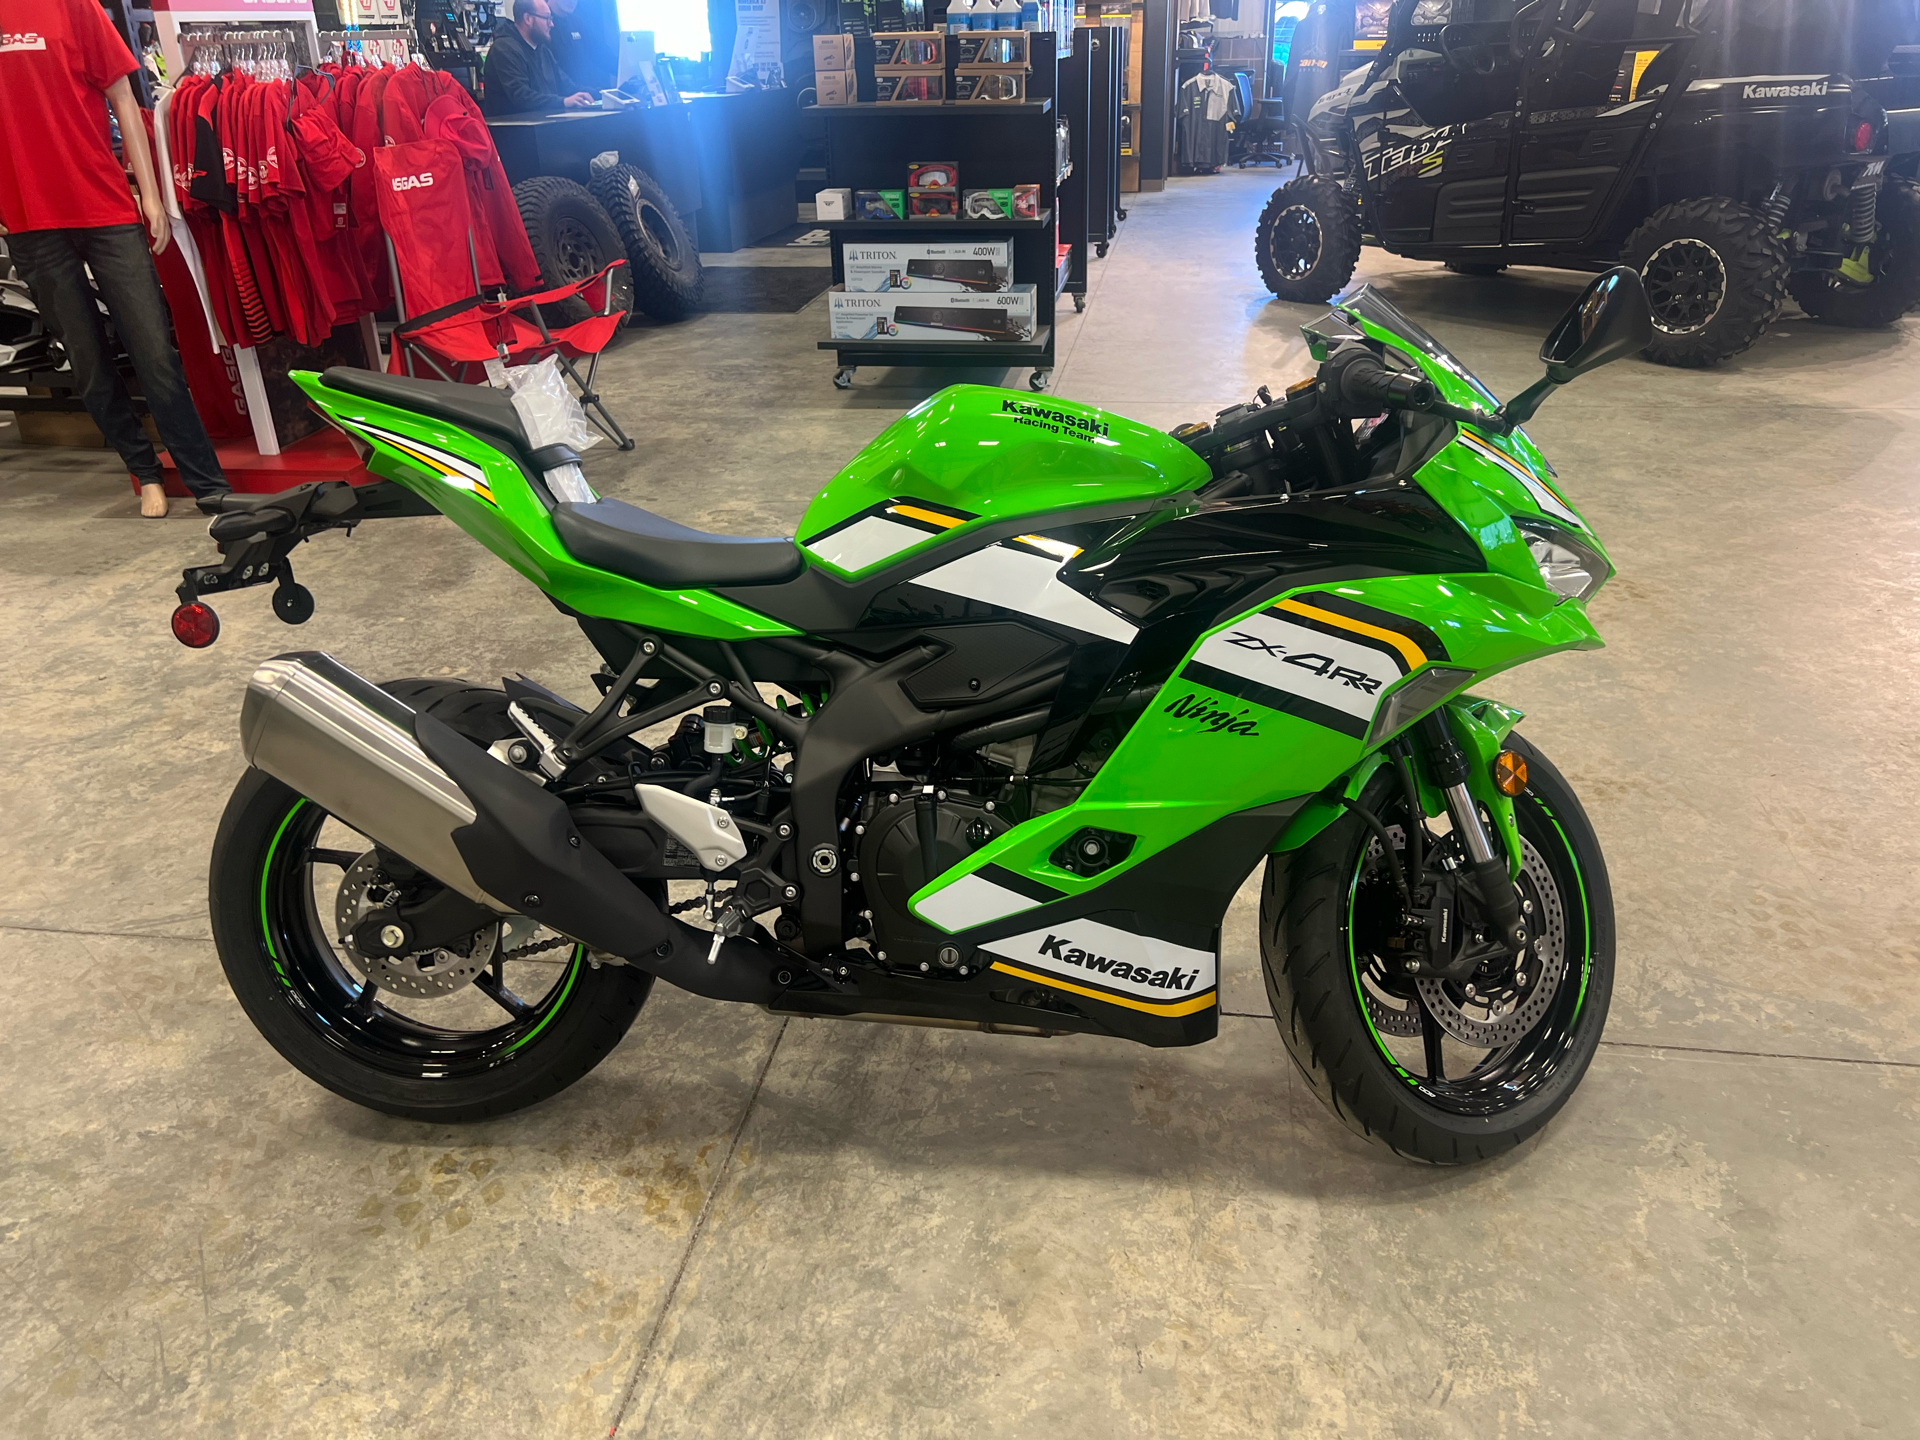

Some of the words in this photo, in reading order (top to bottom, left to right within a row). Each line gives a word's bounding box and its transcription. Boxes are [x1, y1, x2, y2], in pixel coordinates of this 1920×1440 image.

[1742, 82, 1828, 99] Kawasaki
[860, 251, 897, 260] TRITON
[973, 247, 996, 256] 400W
[845, 299, 881, 308] TRITON
[997, 296, 1019, 305] 600W
[1001, 400, 1109, 438] Kawasaki
[1013, 415, 1060, 434] Racing
[1061, 425, 1096, 444] Team
[1223, 631, 1383, 696] ZX-4RR
[1163, 693, 1260, 737] Ninja
[1441, 908, 1449, 943] Kawasaki
[1038, 934, 1200, 991] Kawasaki
